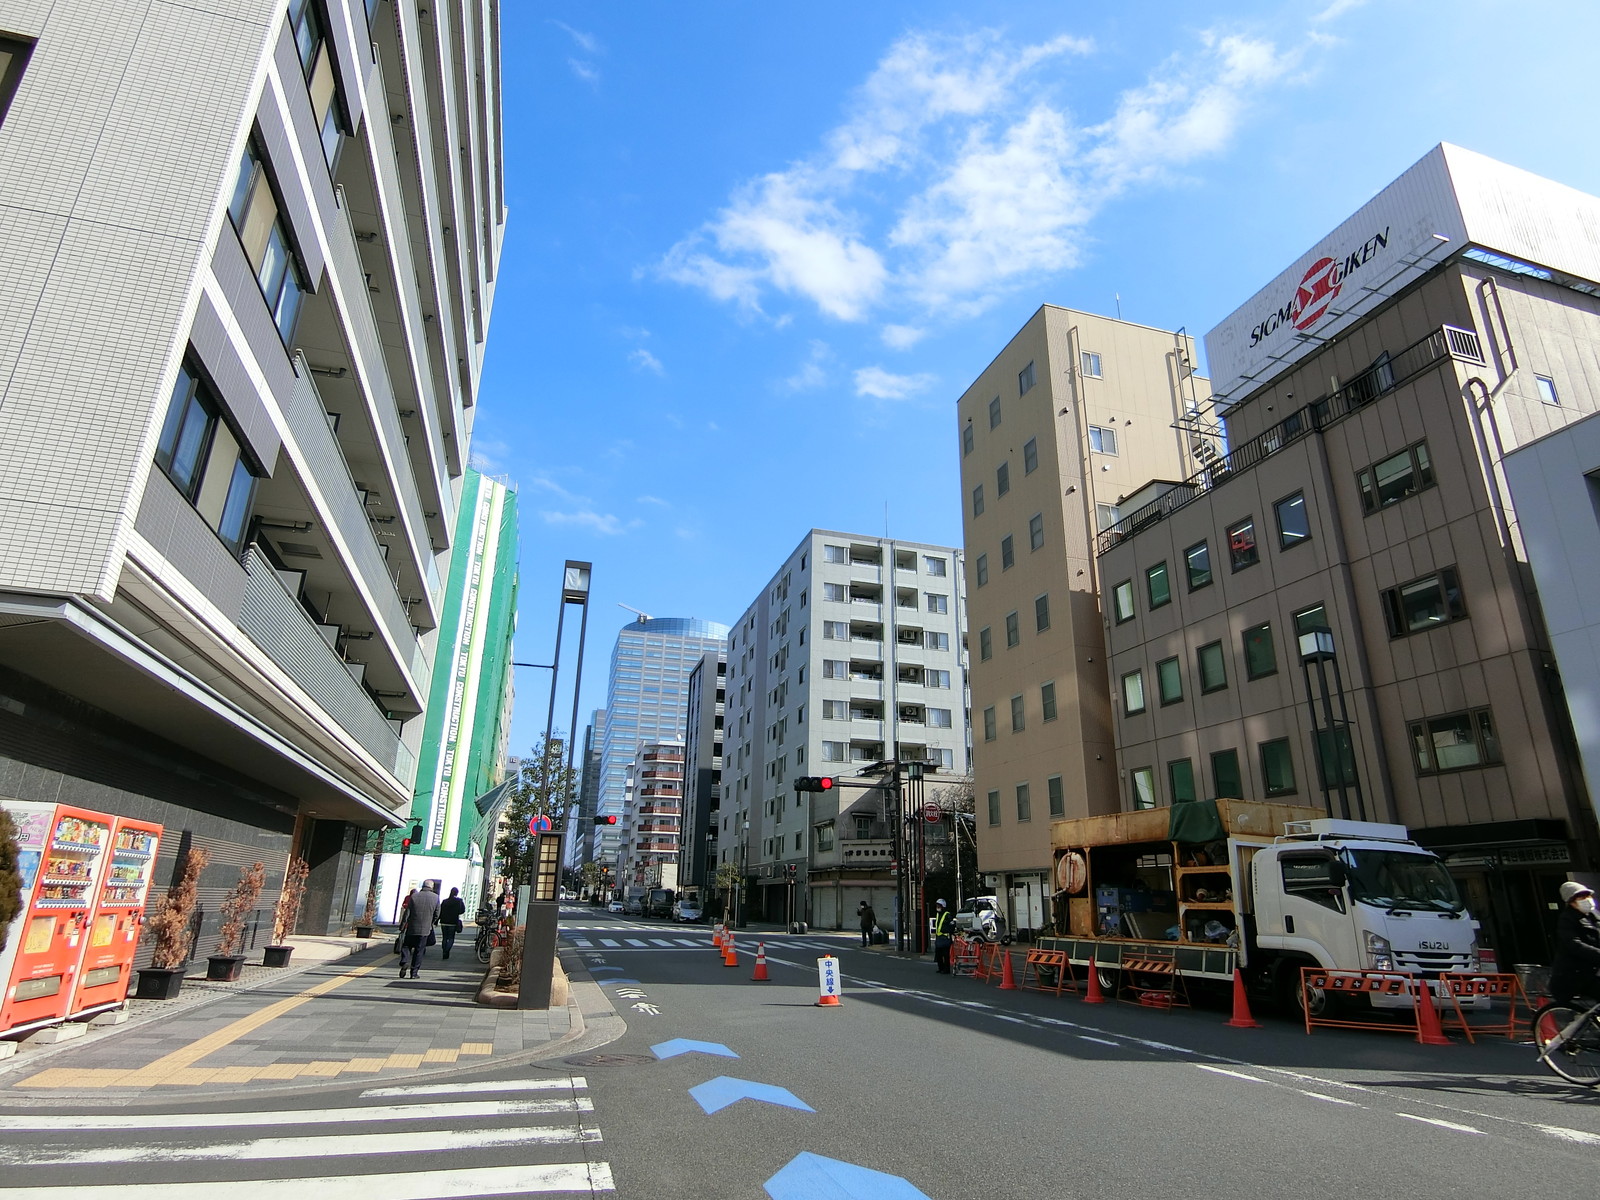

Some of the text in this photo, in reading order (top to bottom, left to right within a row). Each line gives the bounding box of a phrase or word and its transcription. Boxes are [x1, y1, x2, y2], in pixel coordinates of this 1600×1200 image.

[1250, 226, 1389, 348] SIGMA GIKEN
[462, 561, 481, 645] TOKYU CONSTRUCTION
[448, 652, 468, 742] TOKYU CONSTRUCTION
[433, 750, 454, 846] TOKYU CONSTRUCTION
[825, 960, 834, 985] 中央線
[1419, 941, 1449, 950] ISUZU
